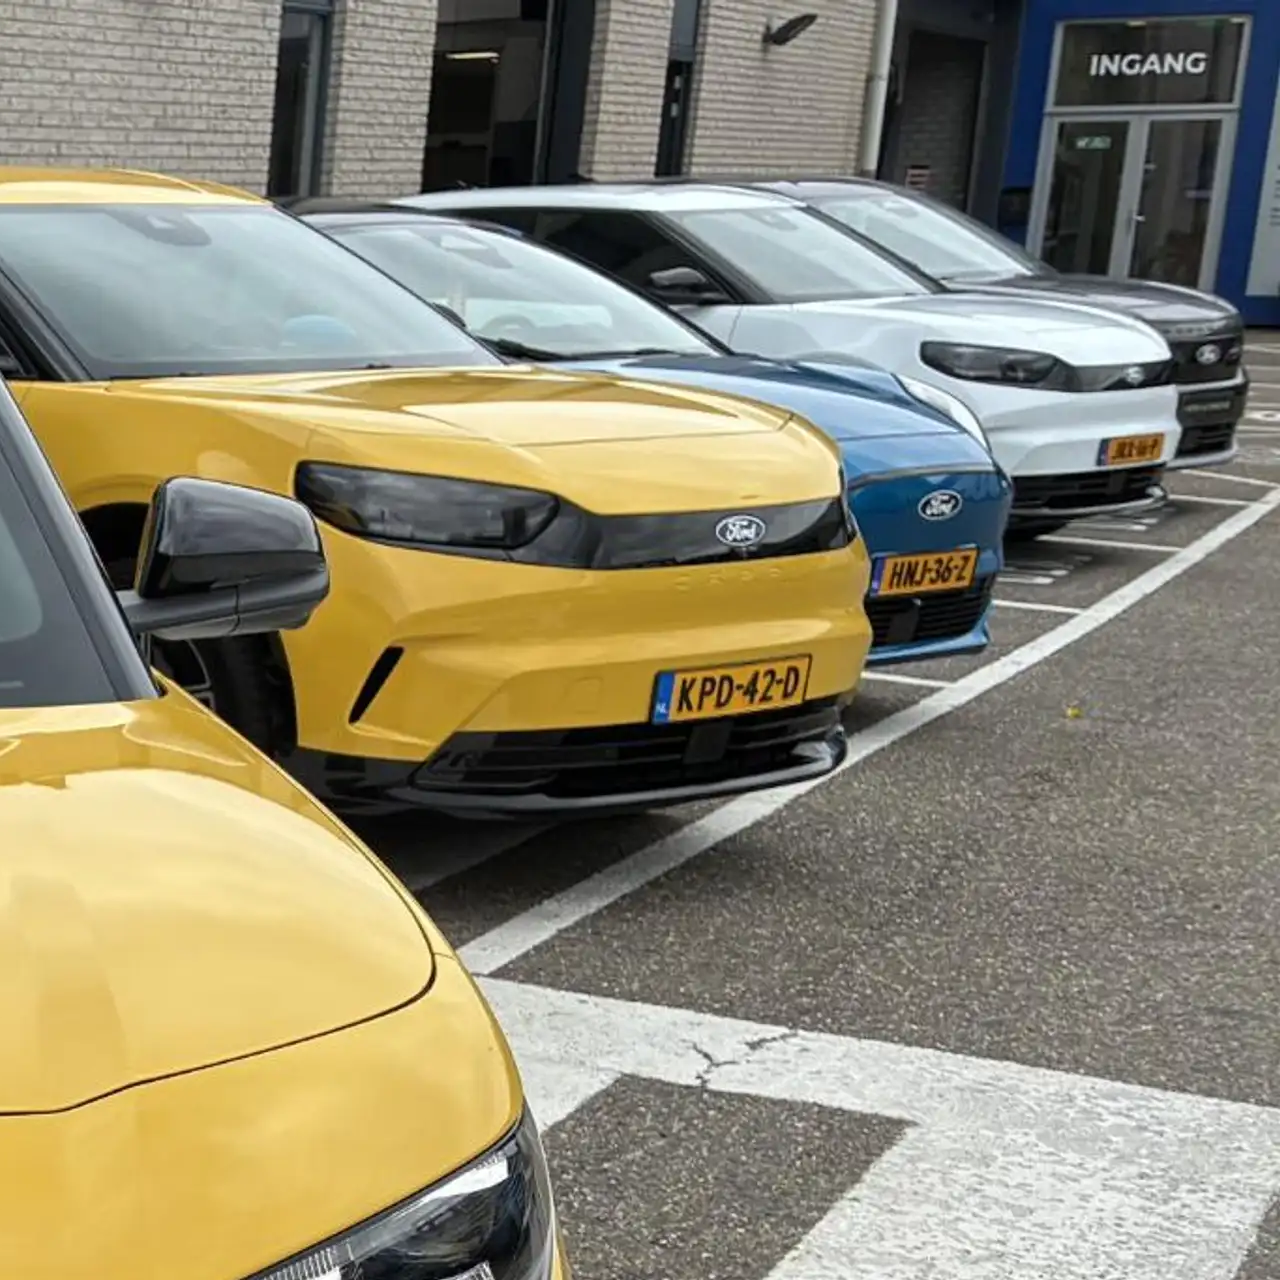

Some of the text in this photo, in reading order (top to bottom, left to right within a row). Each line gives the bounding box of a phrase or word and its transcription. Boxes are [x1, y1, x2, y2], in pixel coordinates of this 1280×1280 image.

[1089, 51, 1207, 76] INGANG
[888, 555, 972, 591] HNJ-36-Z
[677, 665, 800, 713] KPD-42-D
